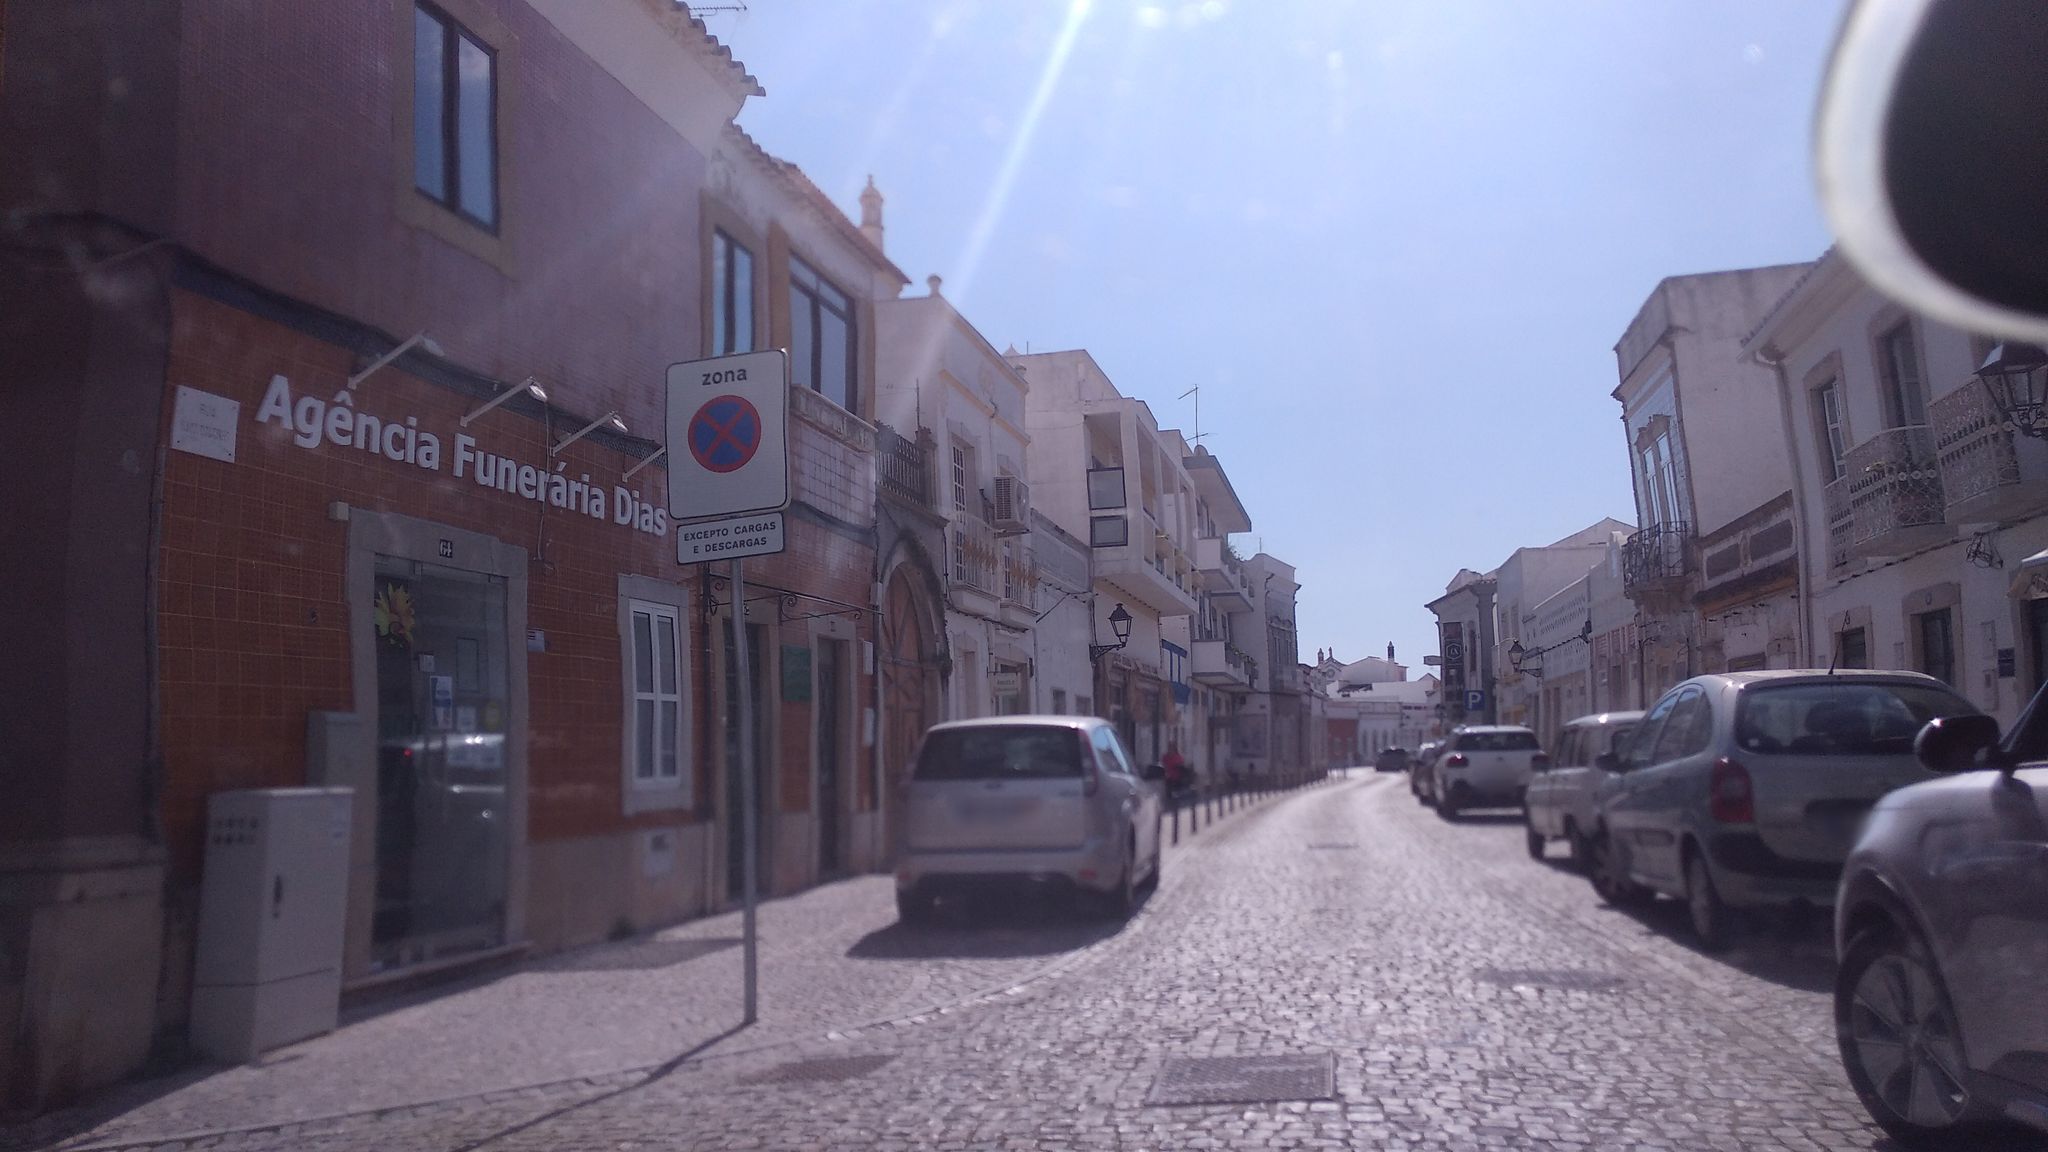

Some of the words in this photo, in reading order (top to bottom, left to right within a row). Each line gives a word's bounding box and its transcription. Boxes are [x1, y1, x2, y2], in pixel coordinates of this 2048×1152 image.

[702, 368, 747, 386] zona
[255, 374, 440, 471] Agência
[453, 433, 605, 520] Funerária
[614, 485, 667, 537] Dias
[684, 528, 729, 542] EXCEPTO
[734, 521, 776, 535] CARGAS
[693, 545, 699, 554] E
[705, 537, 767, 552] DESCARGAS
[1468, 691, 1481, 709] P
